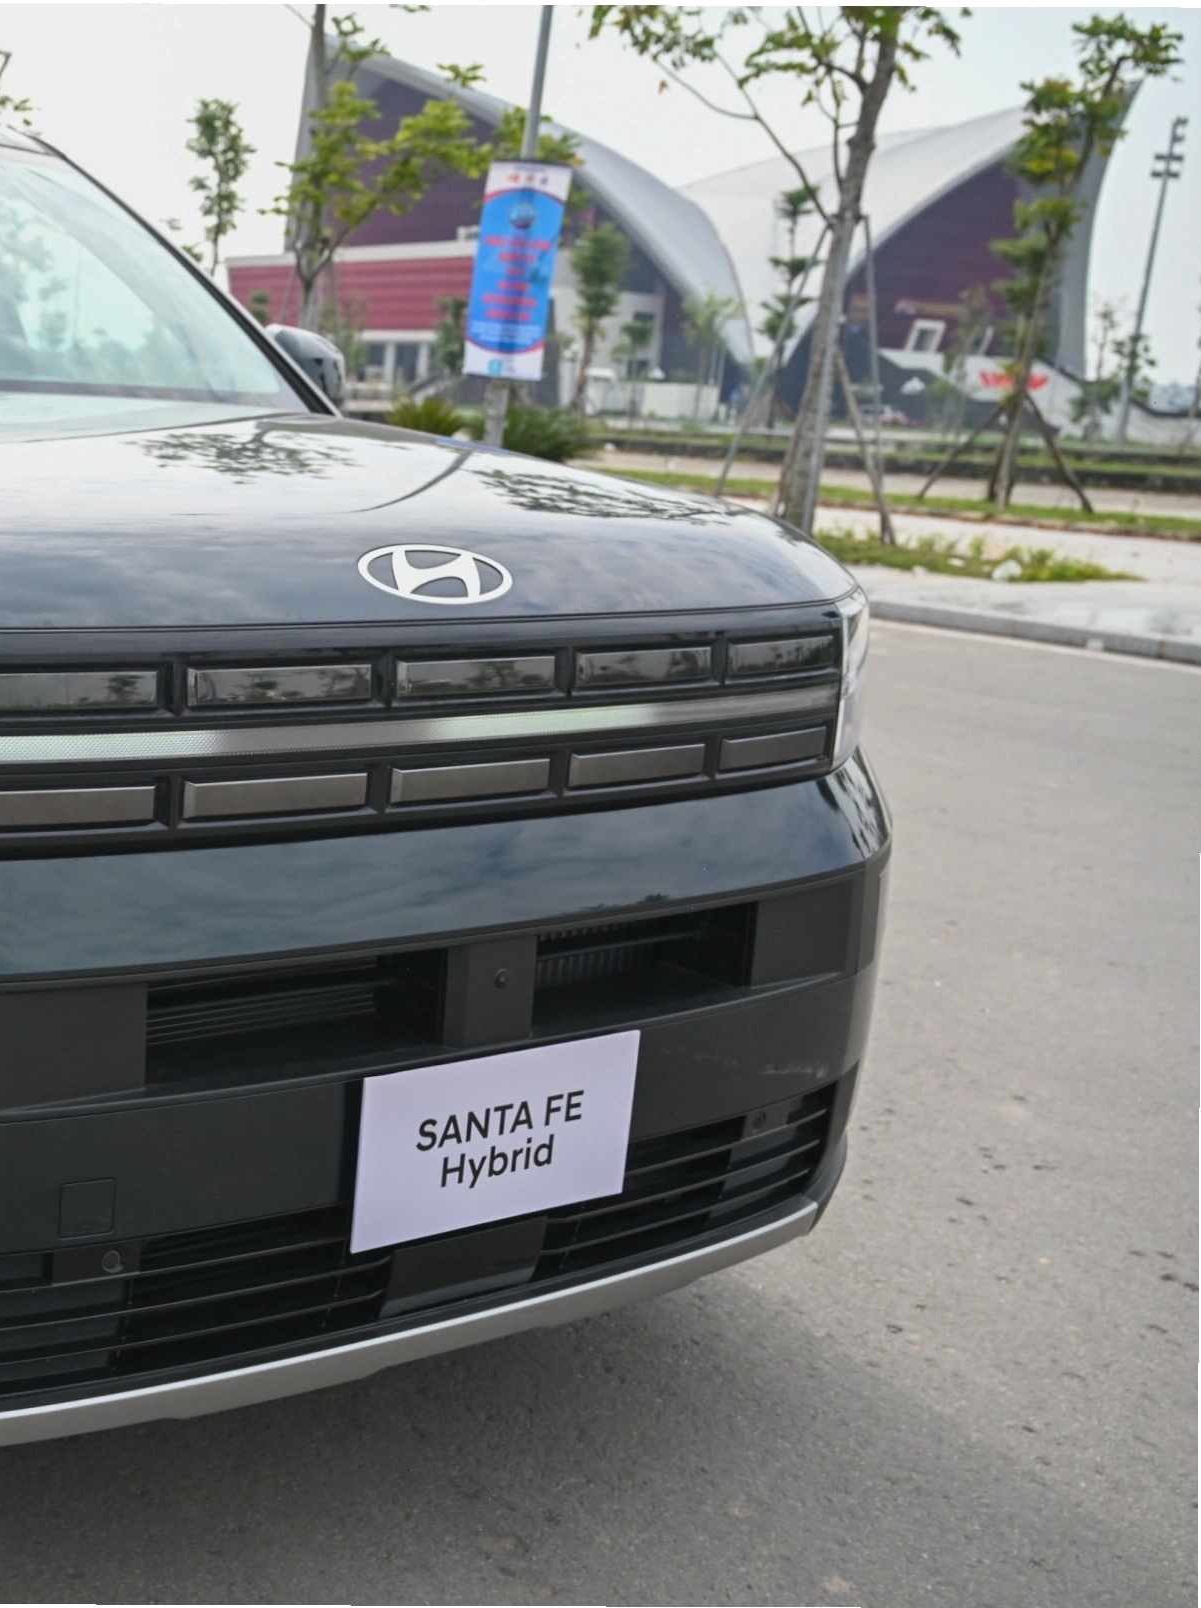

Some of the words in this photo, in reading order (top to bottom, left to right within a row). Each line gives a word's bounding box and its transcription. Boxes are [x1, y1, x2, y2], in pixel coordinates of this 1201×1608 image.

[415, 1100, 534, 1152] SANTA
[544, 1089, 585, 1127] FE
[440, 1133, 555, 1189] Hybrid
